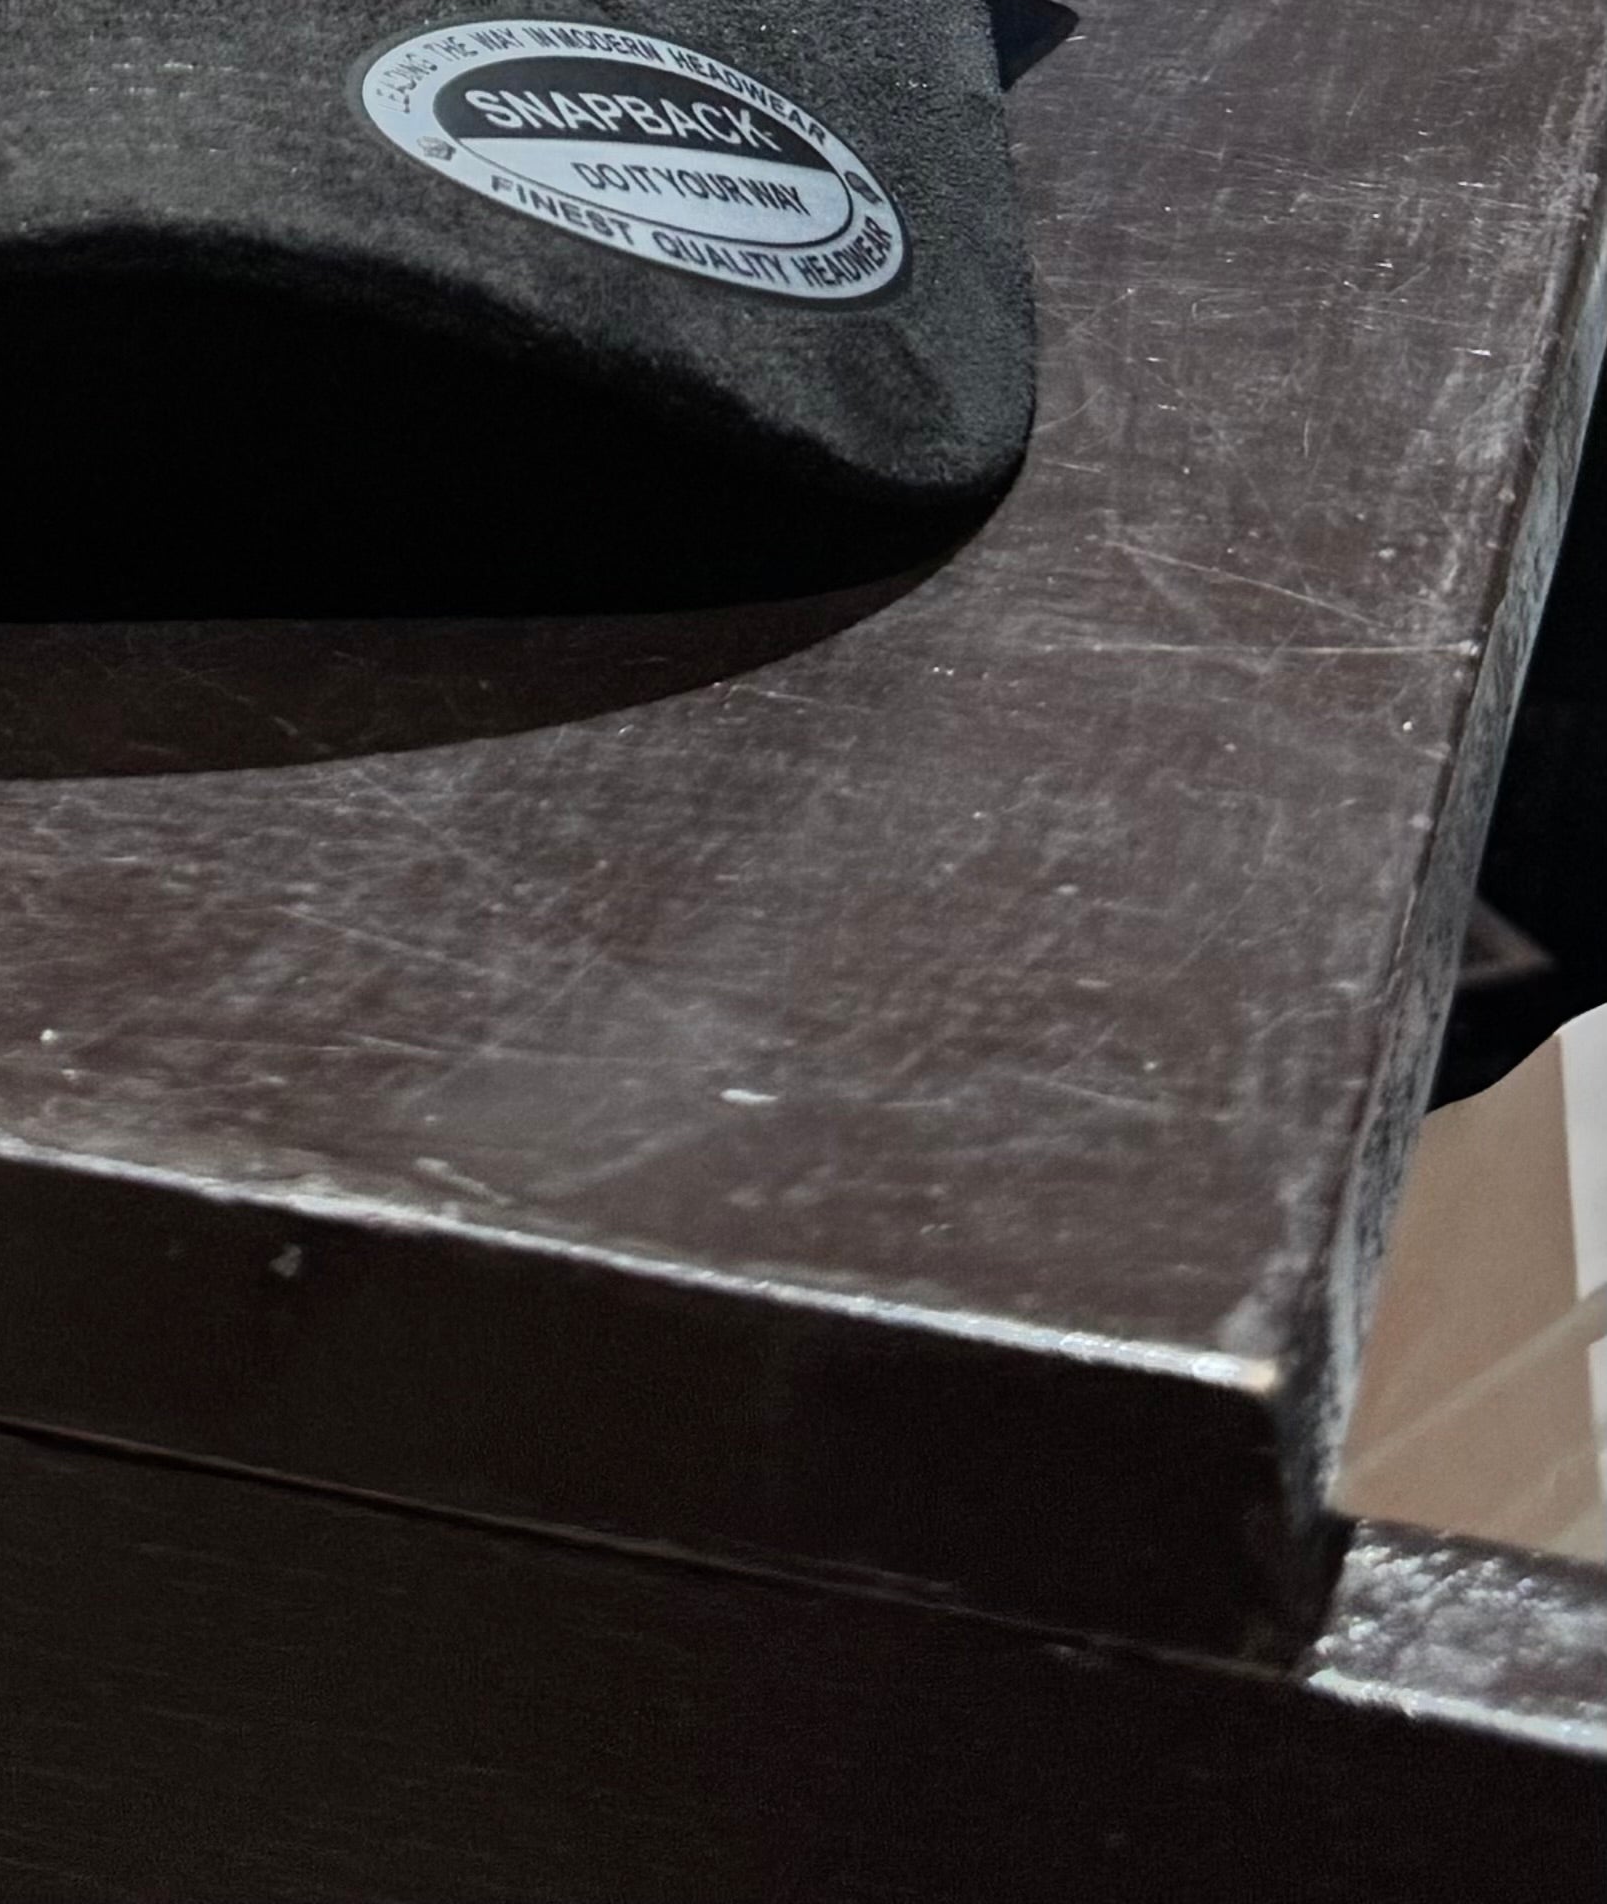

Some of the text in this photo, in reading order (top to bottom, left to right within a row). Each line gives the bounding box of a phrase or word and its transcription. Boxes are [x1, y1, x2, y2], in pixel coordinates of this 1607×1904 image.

[423, 36, 478, 62] THE
[468, 27, 524, 51] WAY
[522, 27, 556, 49] IN
[554, 28, 666, 64] MODERN
[668, 47, 827, 146] HEADWEAR
[465, 89, 782, 154] SNAPBACK
[490, 175, 893, 288] FINEST QUALITY HEADWEAR
[571, 162, 811, 216] DO IT YOUR WAY
